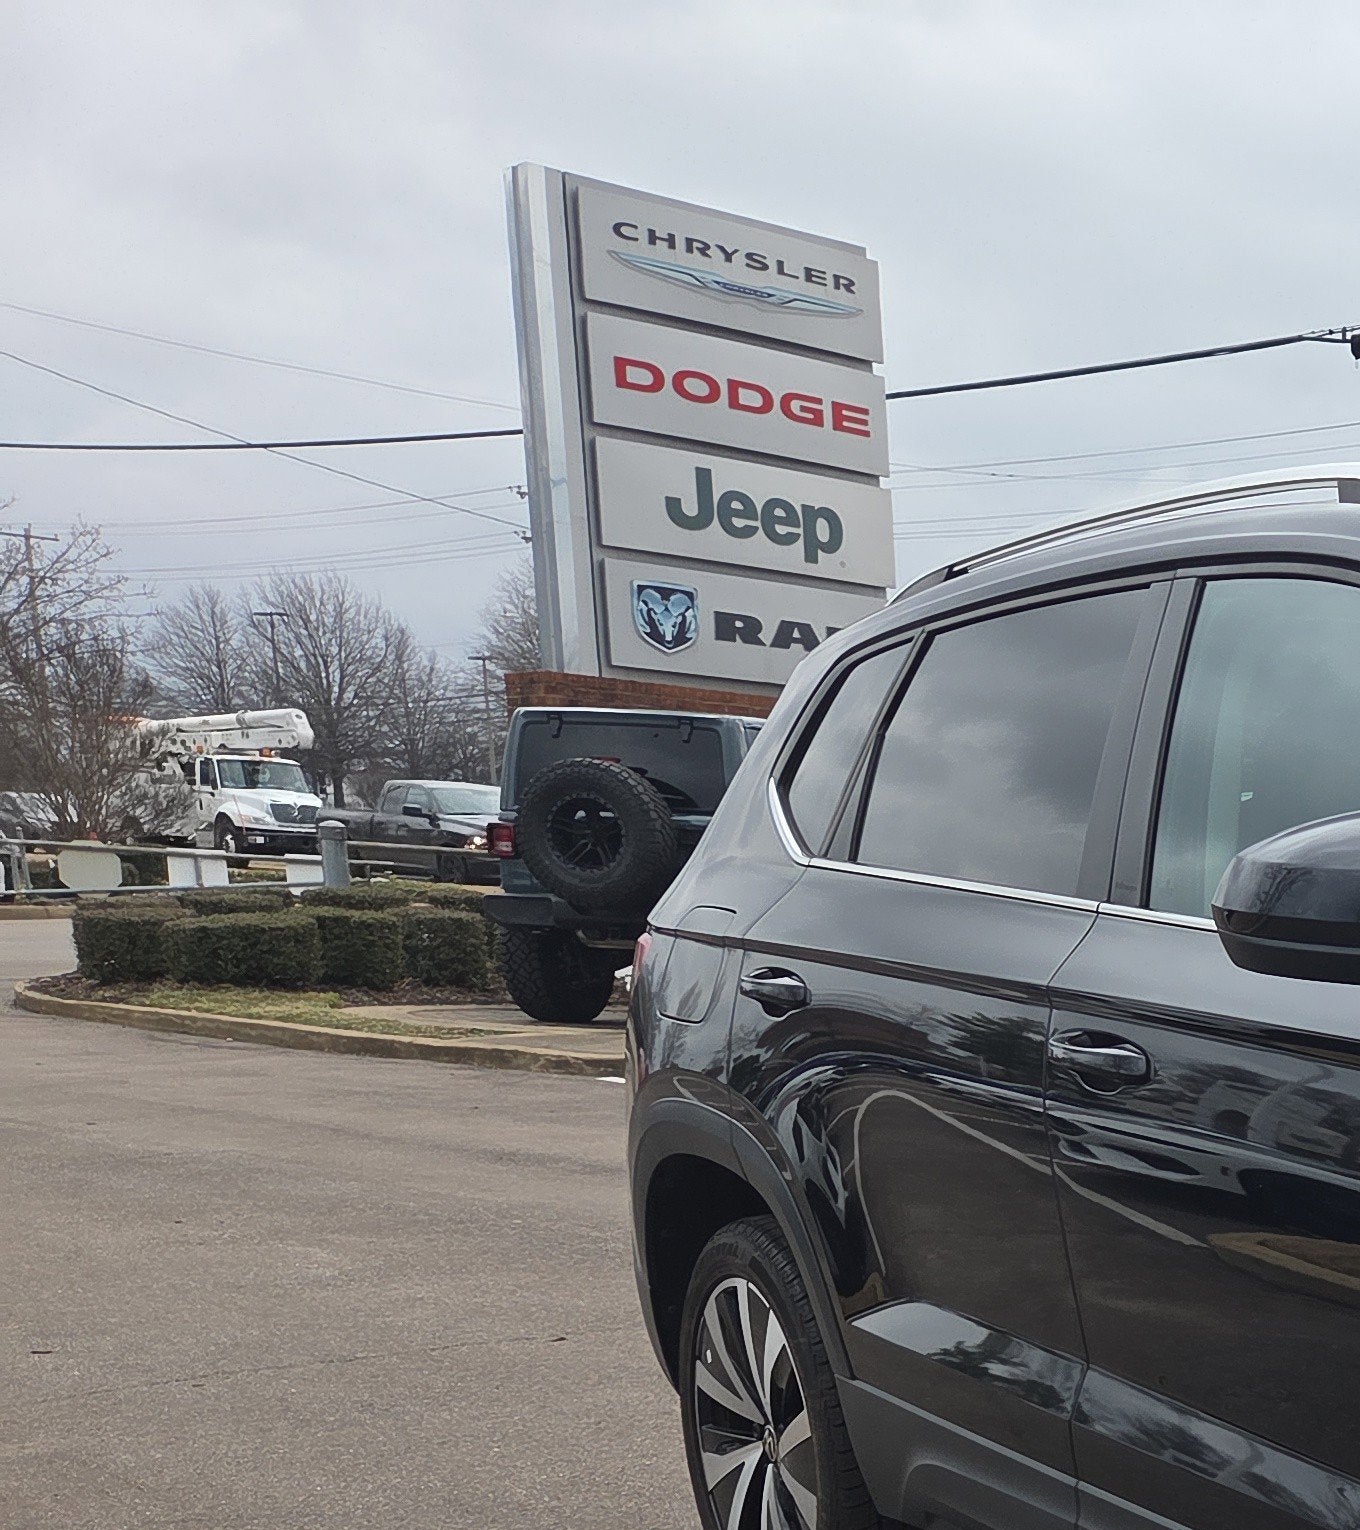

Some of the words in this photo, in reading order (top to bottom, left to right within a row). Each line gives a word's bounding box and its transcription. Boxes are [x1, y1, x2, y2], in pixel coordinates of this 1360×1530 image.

[611, 221, 857, 295] CHRYSLER
[613, 356, 871, 438] DODGE
[664, 466, 844, 565] Jeep
[713, 610, 845, 653] RA
